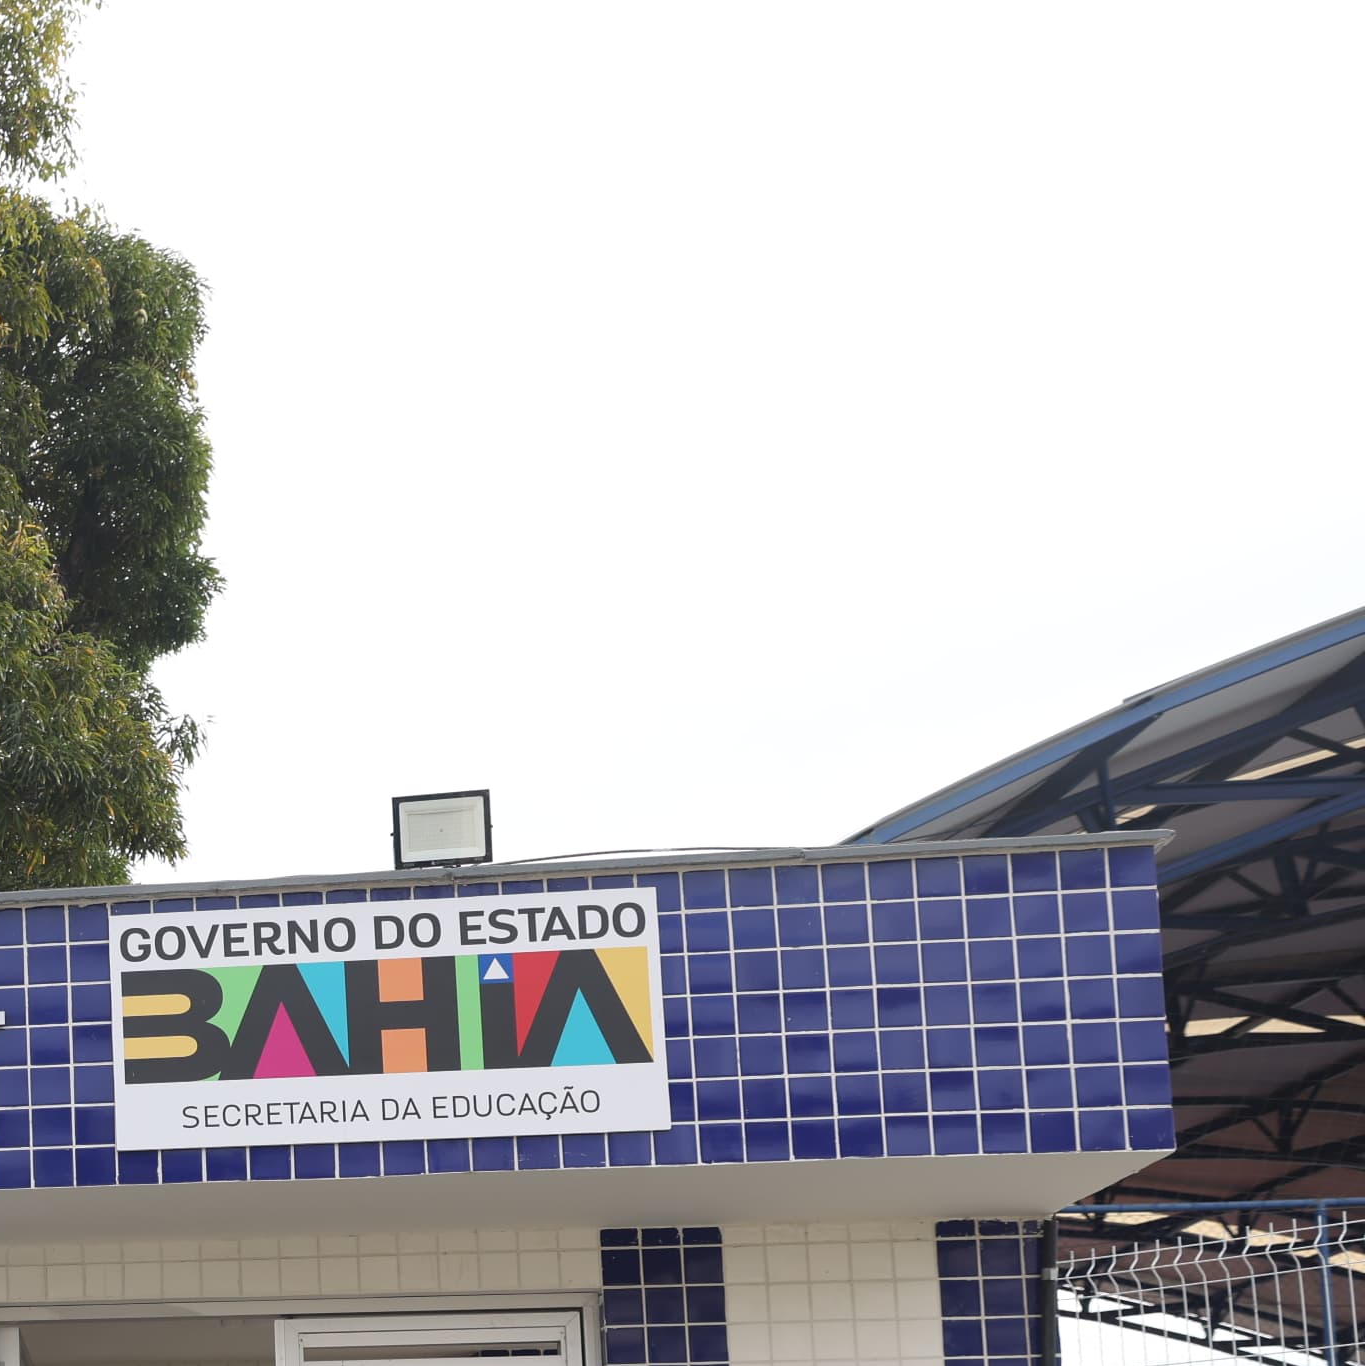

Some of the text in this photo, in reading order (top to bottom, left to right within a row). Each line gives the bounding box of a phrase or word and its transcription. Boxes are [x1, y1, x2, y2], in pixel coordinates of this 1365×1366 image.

[119, 902, 647, 963] GOVERNO DO ESTADO
[121, 946, 655, 1085] BAHIA
[181, 1085, 602, 1129] SECRETARIA DA EDUCAÇÃO
